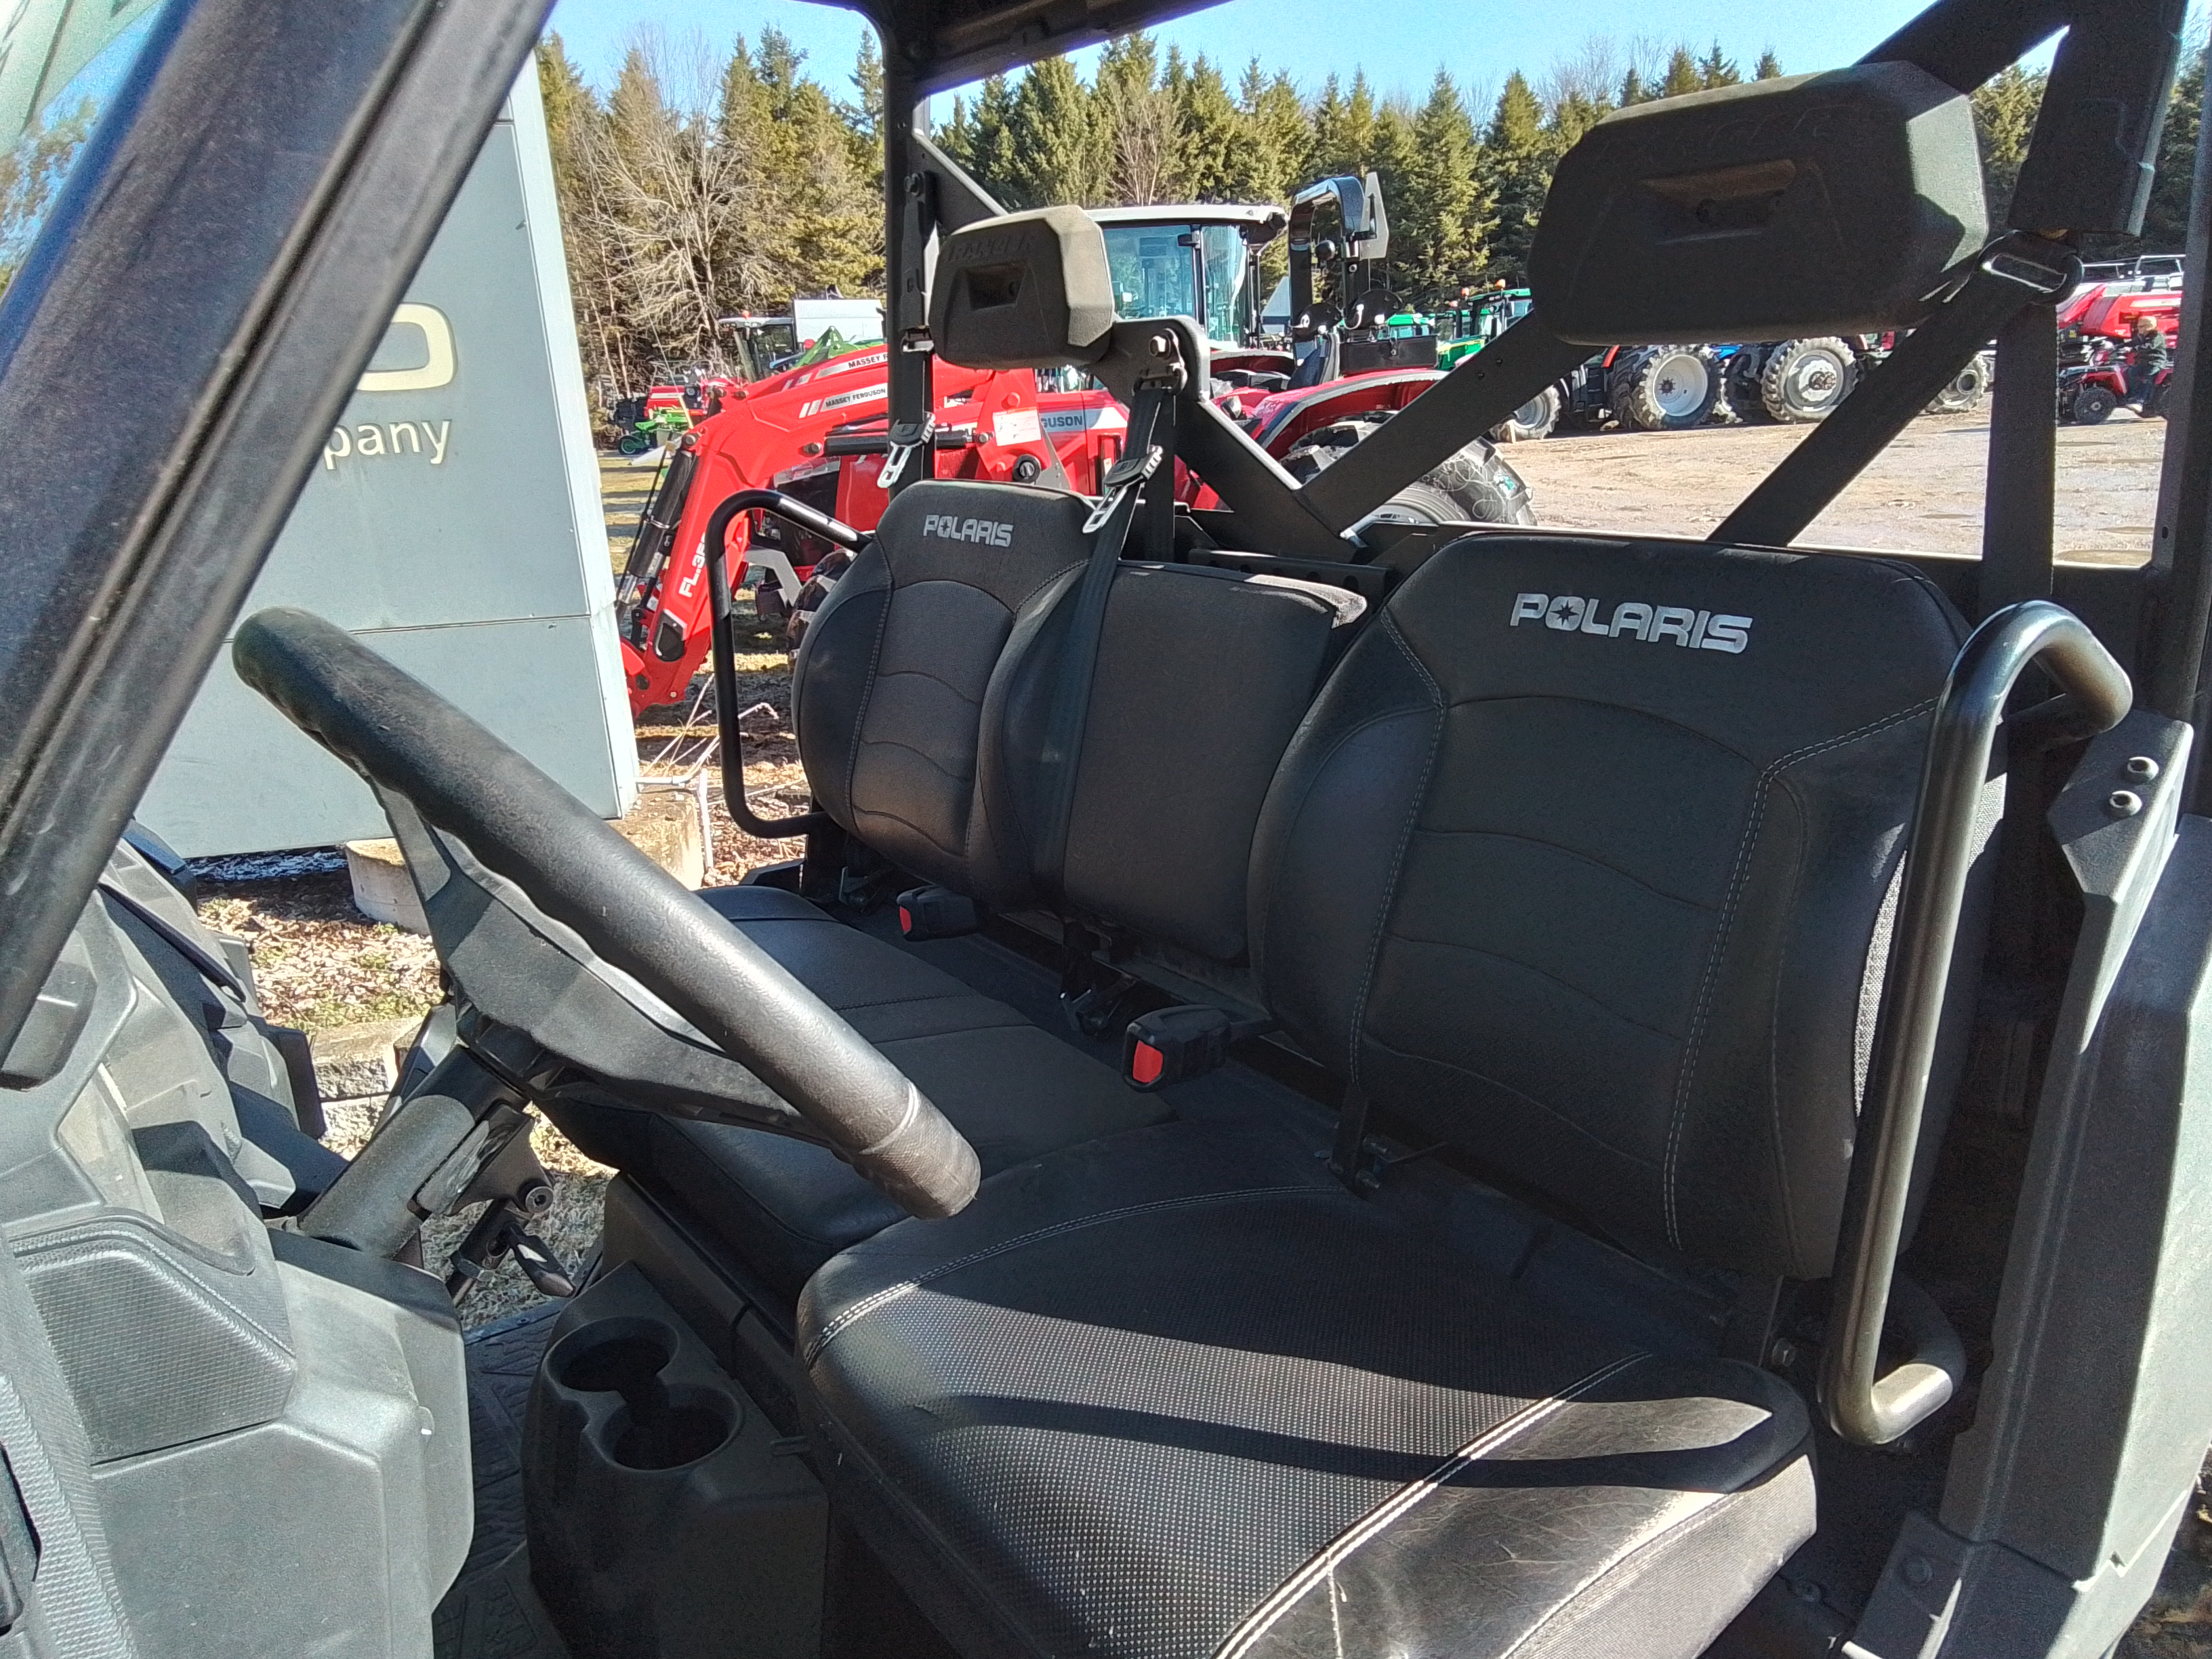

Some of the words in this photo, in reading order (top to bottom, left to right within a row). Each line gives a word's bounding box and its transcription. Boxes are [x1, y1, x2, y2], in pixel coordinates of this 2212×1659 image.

[848, 355, 880, 368] MASSEY
[825, 396, 851, 407] MASSEY
[853, 388, 886, 401] FERGUSON
[1041, 415, 1083, 428] GUSON
[324, 419, 453, 470] pany
[923, 514, 1014, 547] POLARIS
[678, 531, 705, 598] FL.3
[1510, 593, 1753, 654] POLARIS
